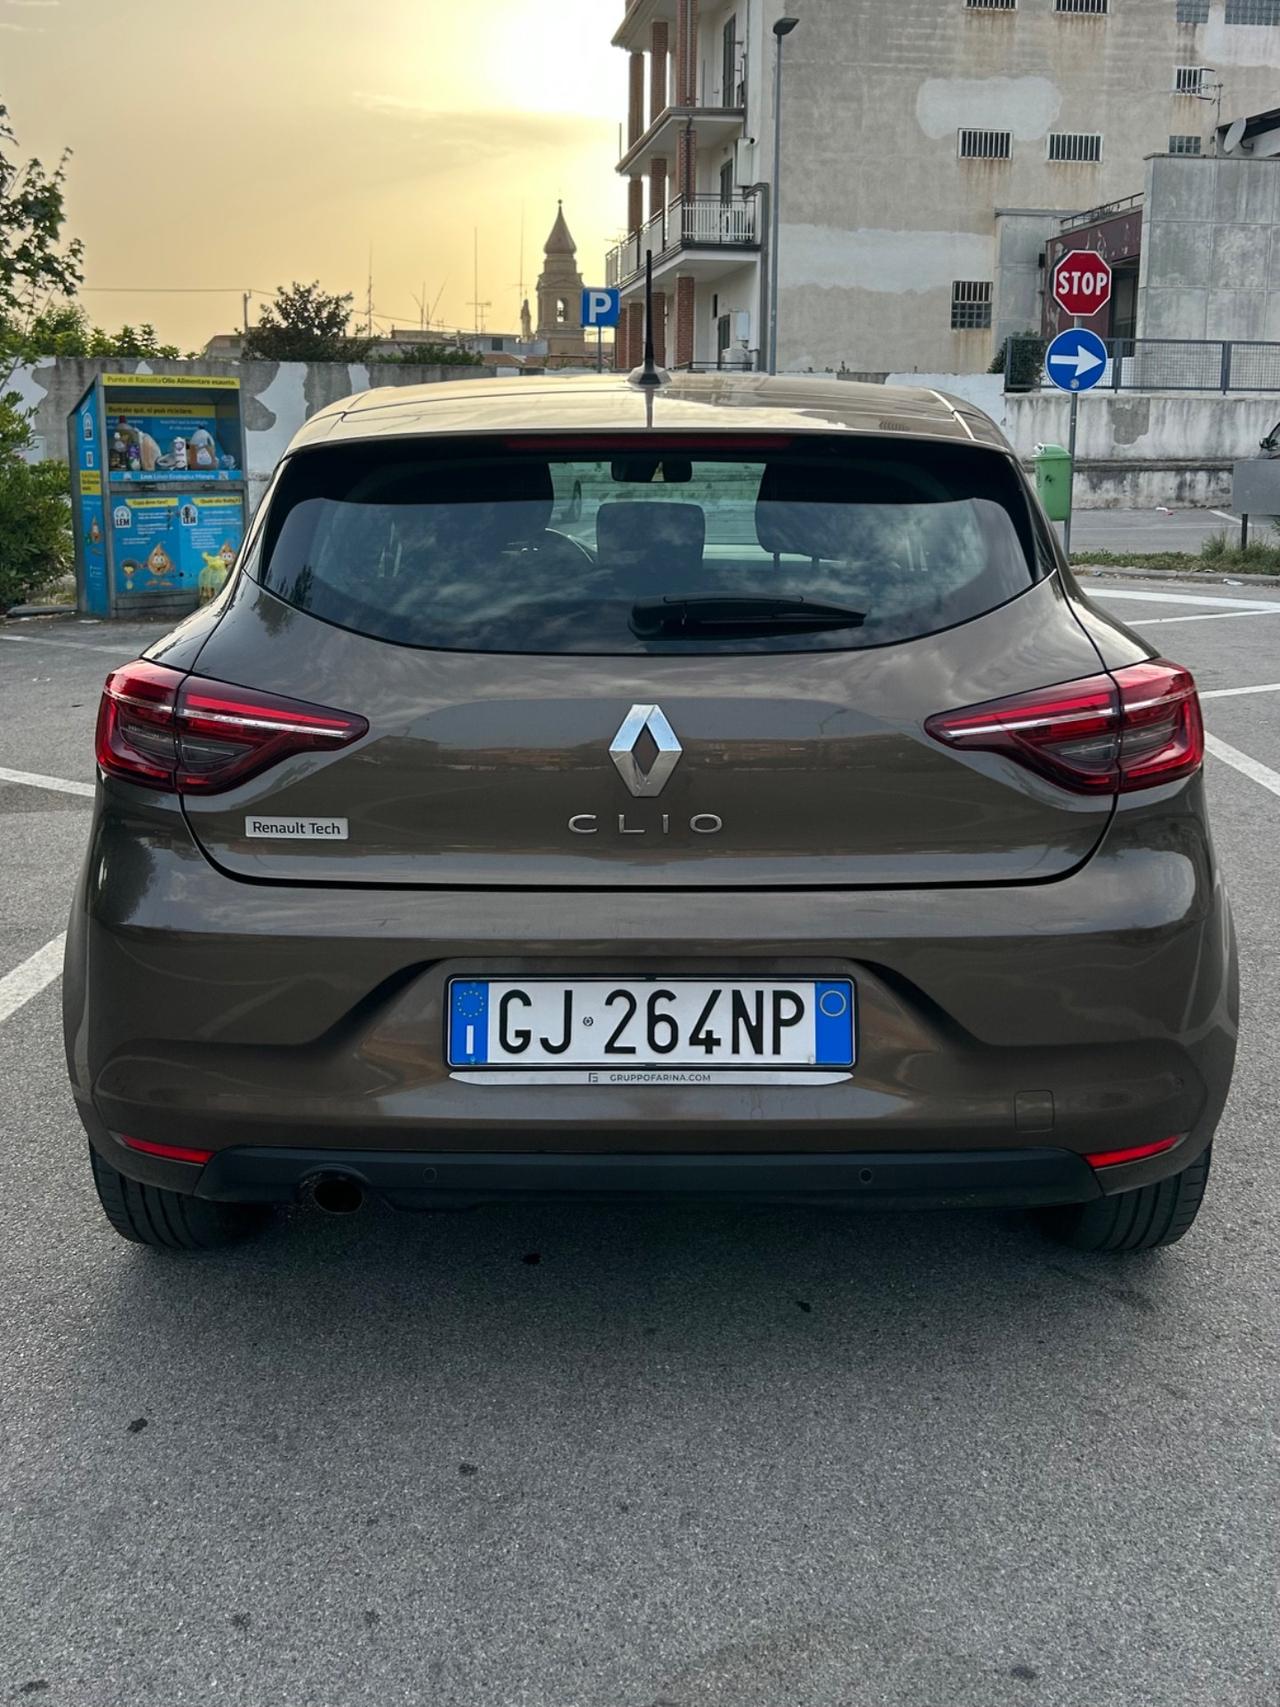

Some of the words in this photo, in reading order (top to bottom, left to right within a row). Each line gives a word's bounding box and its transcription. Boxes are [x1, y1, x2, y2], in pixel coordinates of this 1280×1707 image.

[1058, 271, 1108, 296] STOP
[589, 292, 612, 323] P
[107, 376, 127, 384] Punto
[135, 376, 161, 384] Raccolta
[162, 377, 176, 385] Olio
[177, 377, 210, 386] Alimentare
[116, 518, 130, 526] LEM
[253, 821, 306, 834] Renault
[309, 822, 341, 835] Tech
[568, 813, 723, 834] CLIO
[609, 1073, 711, 1082] GRUPPOFARINA.COM
